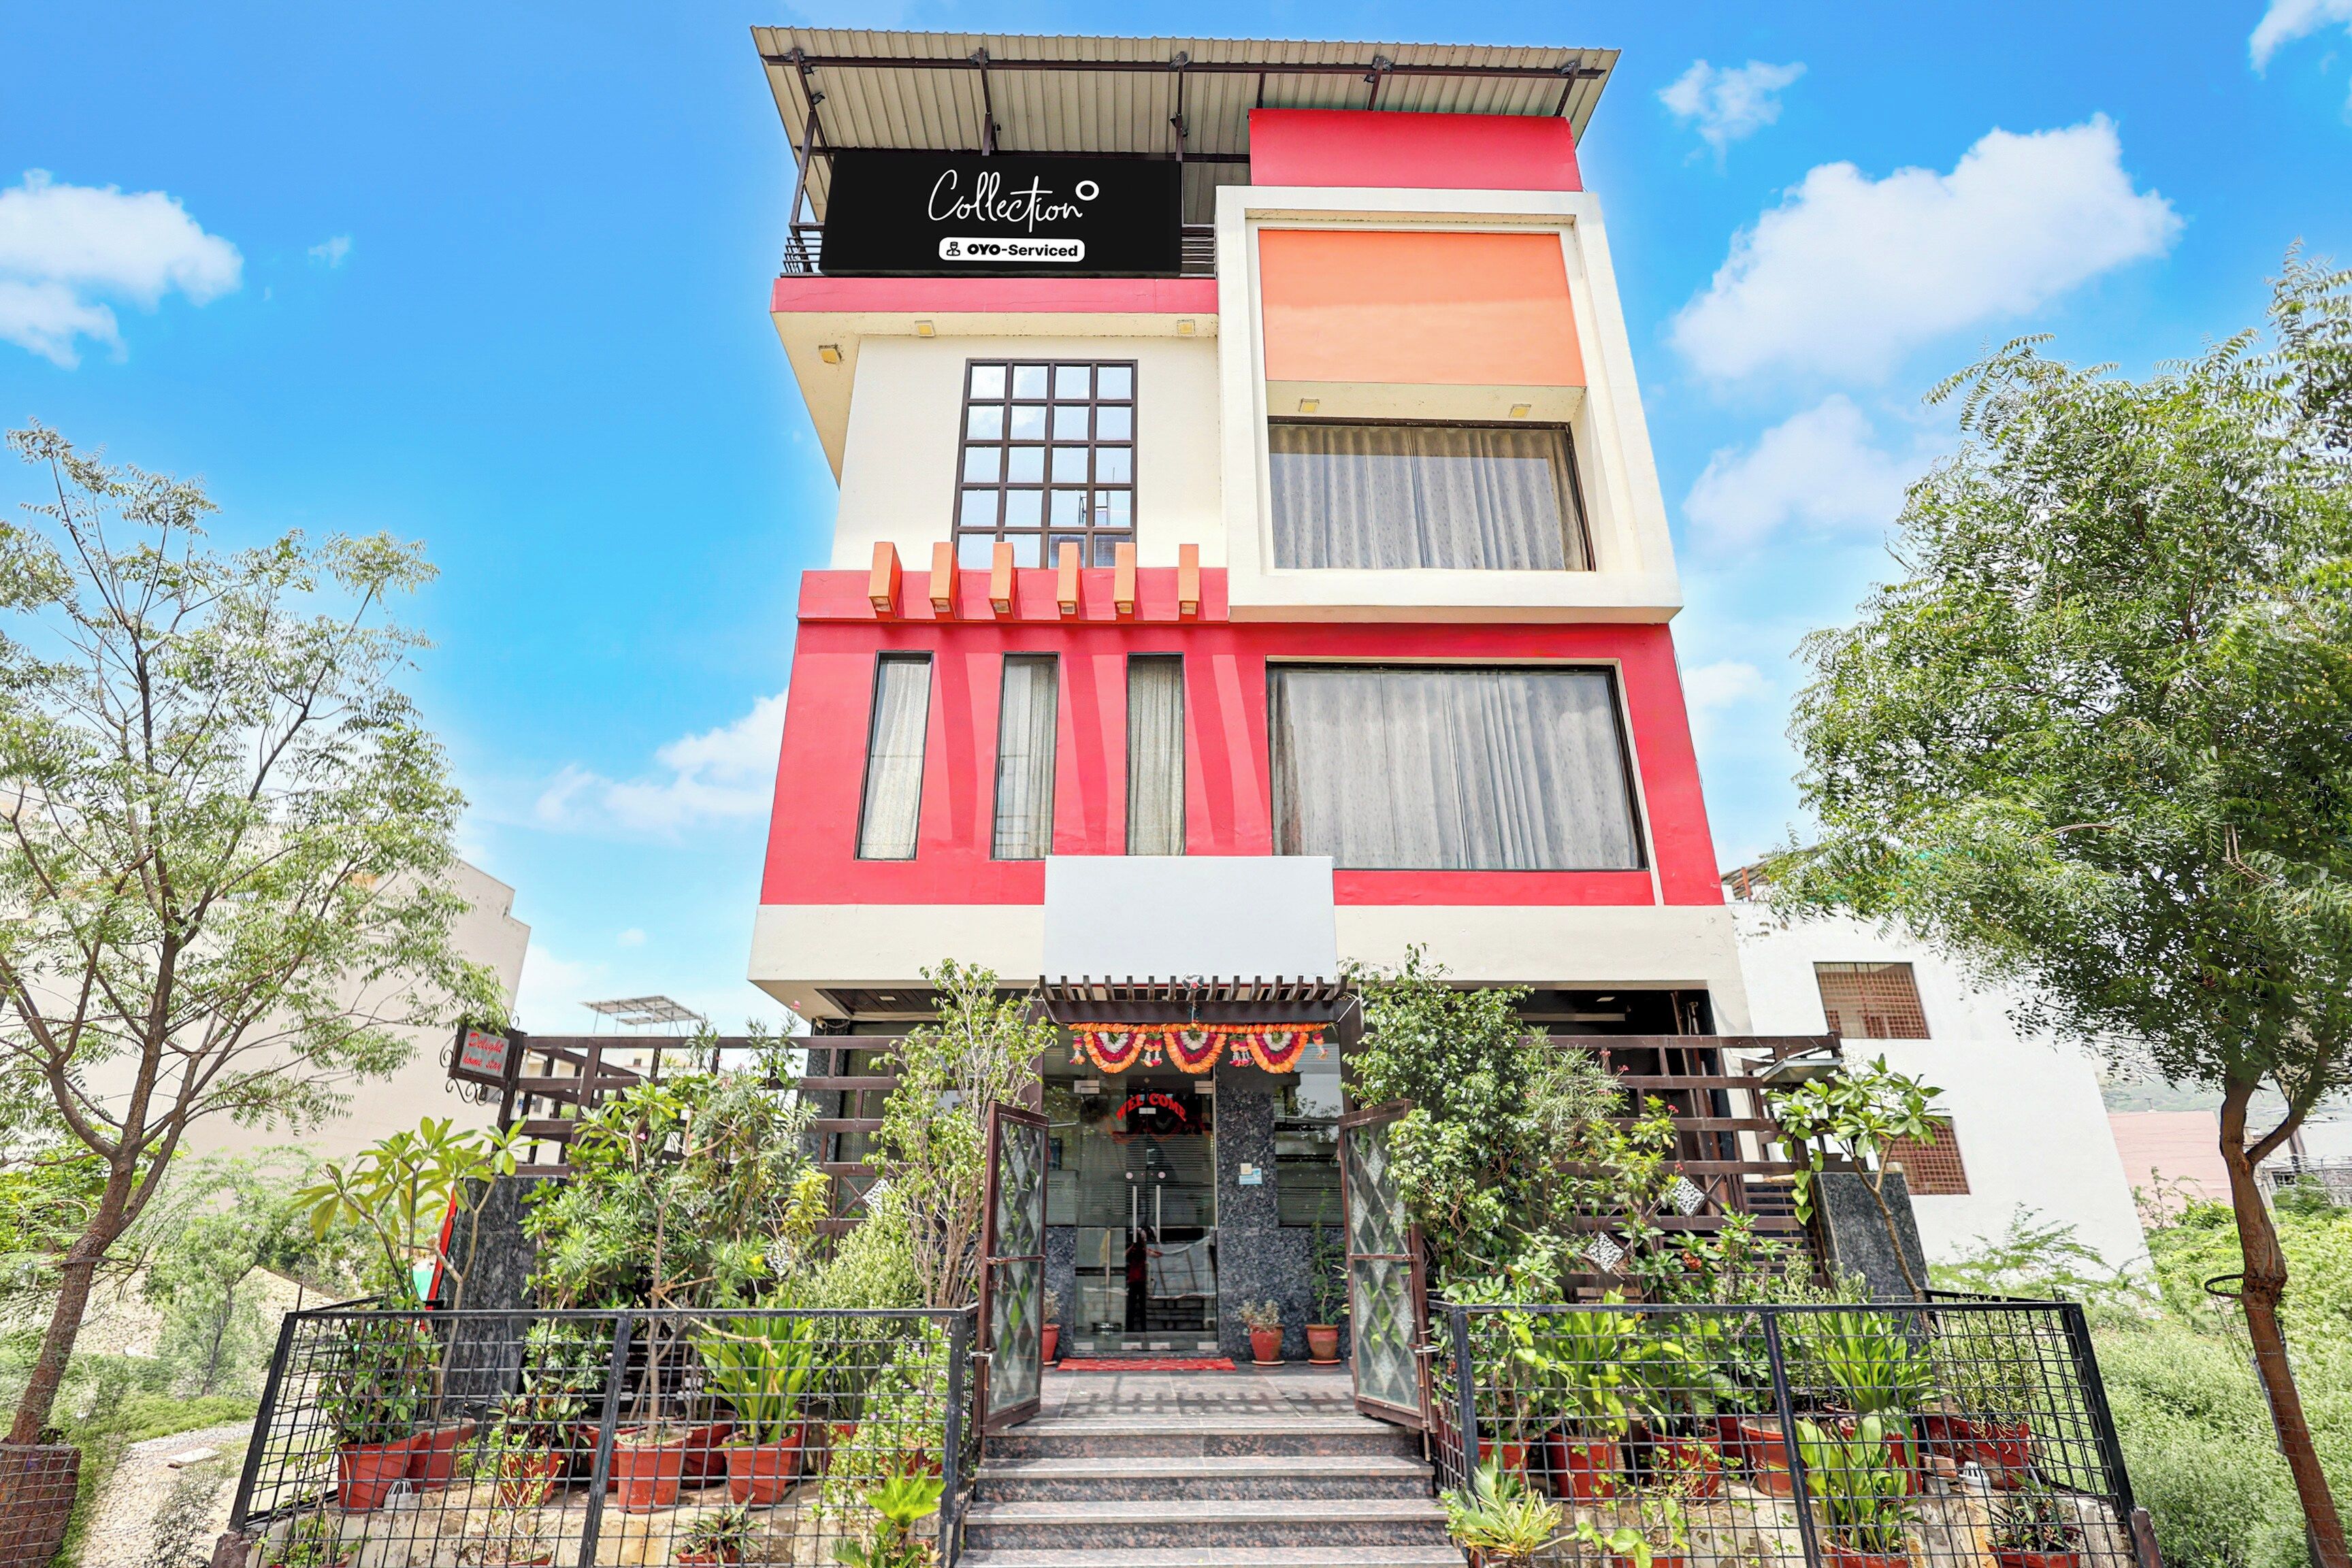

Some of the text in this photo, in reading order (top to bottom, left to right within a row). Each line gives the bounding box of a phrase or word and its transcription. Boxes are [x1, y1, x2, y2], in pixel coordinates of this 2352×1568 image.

[928, 169, 1083, 233] Collection
[966, 242, 1078, 257] OYO-Serviced
[468, 1032, 504, 1056] Delight
[1116, 1092, 1187, 1122] WEL COME
